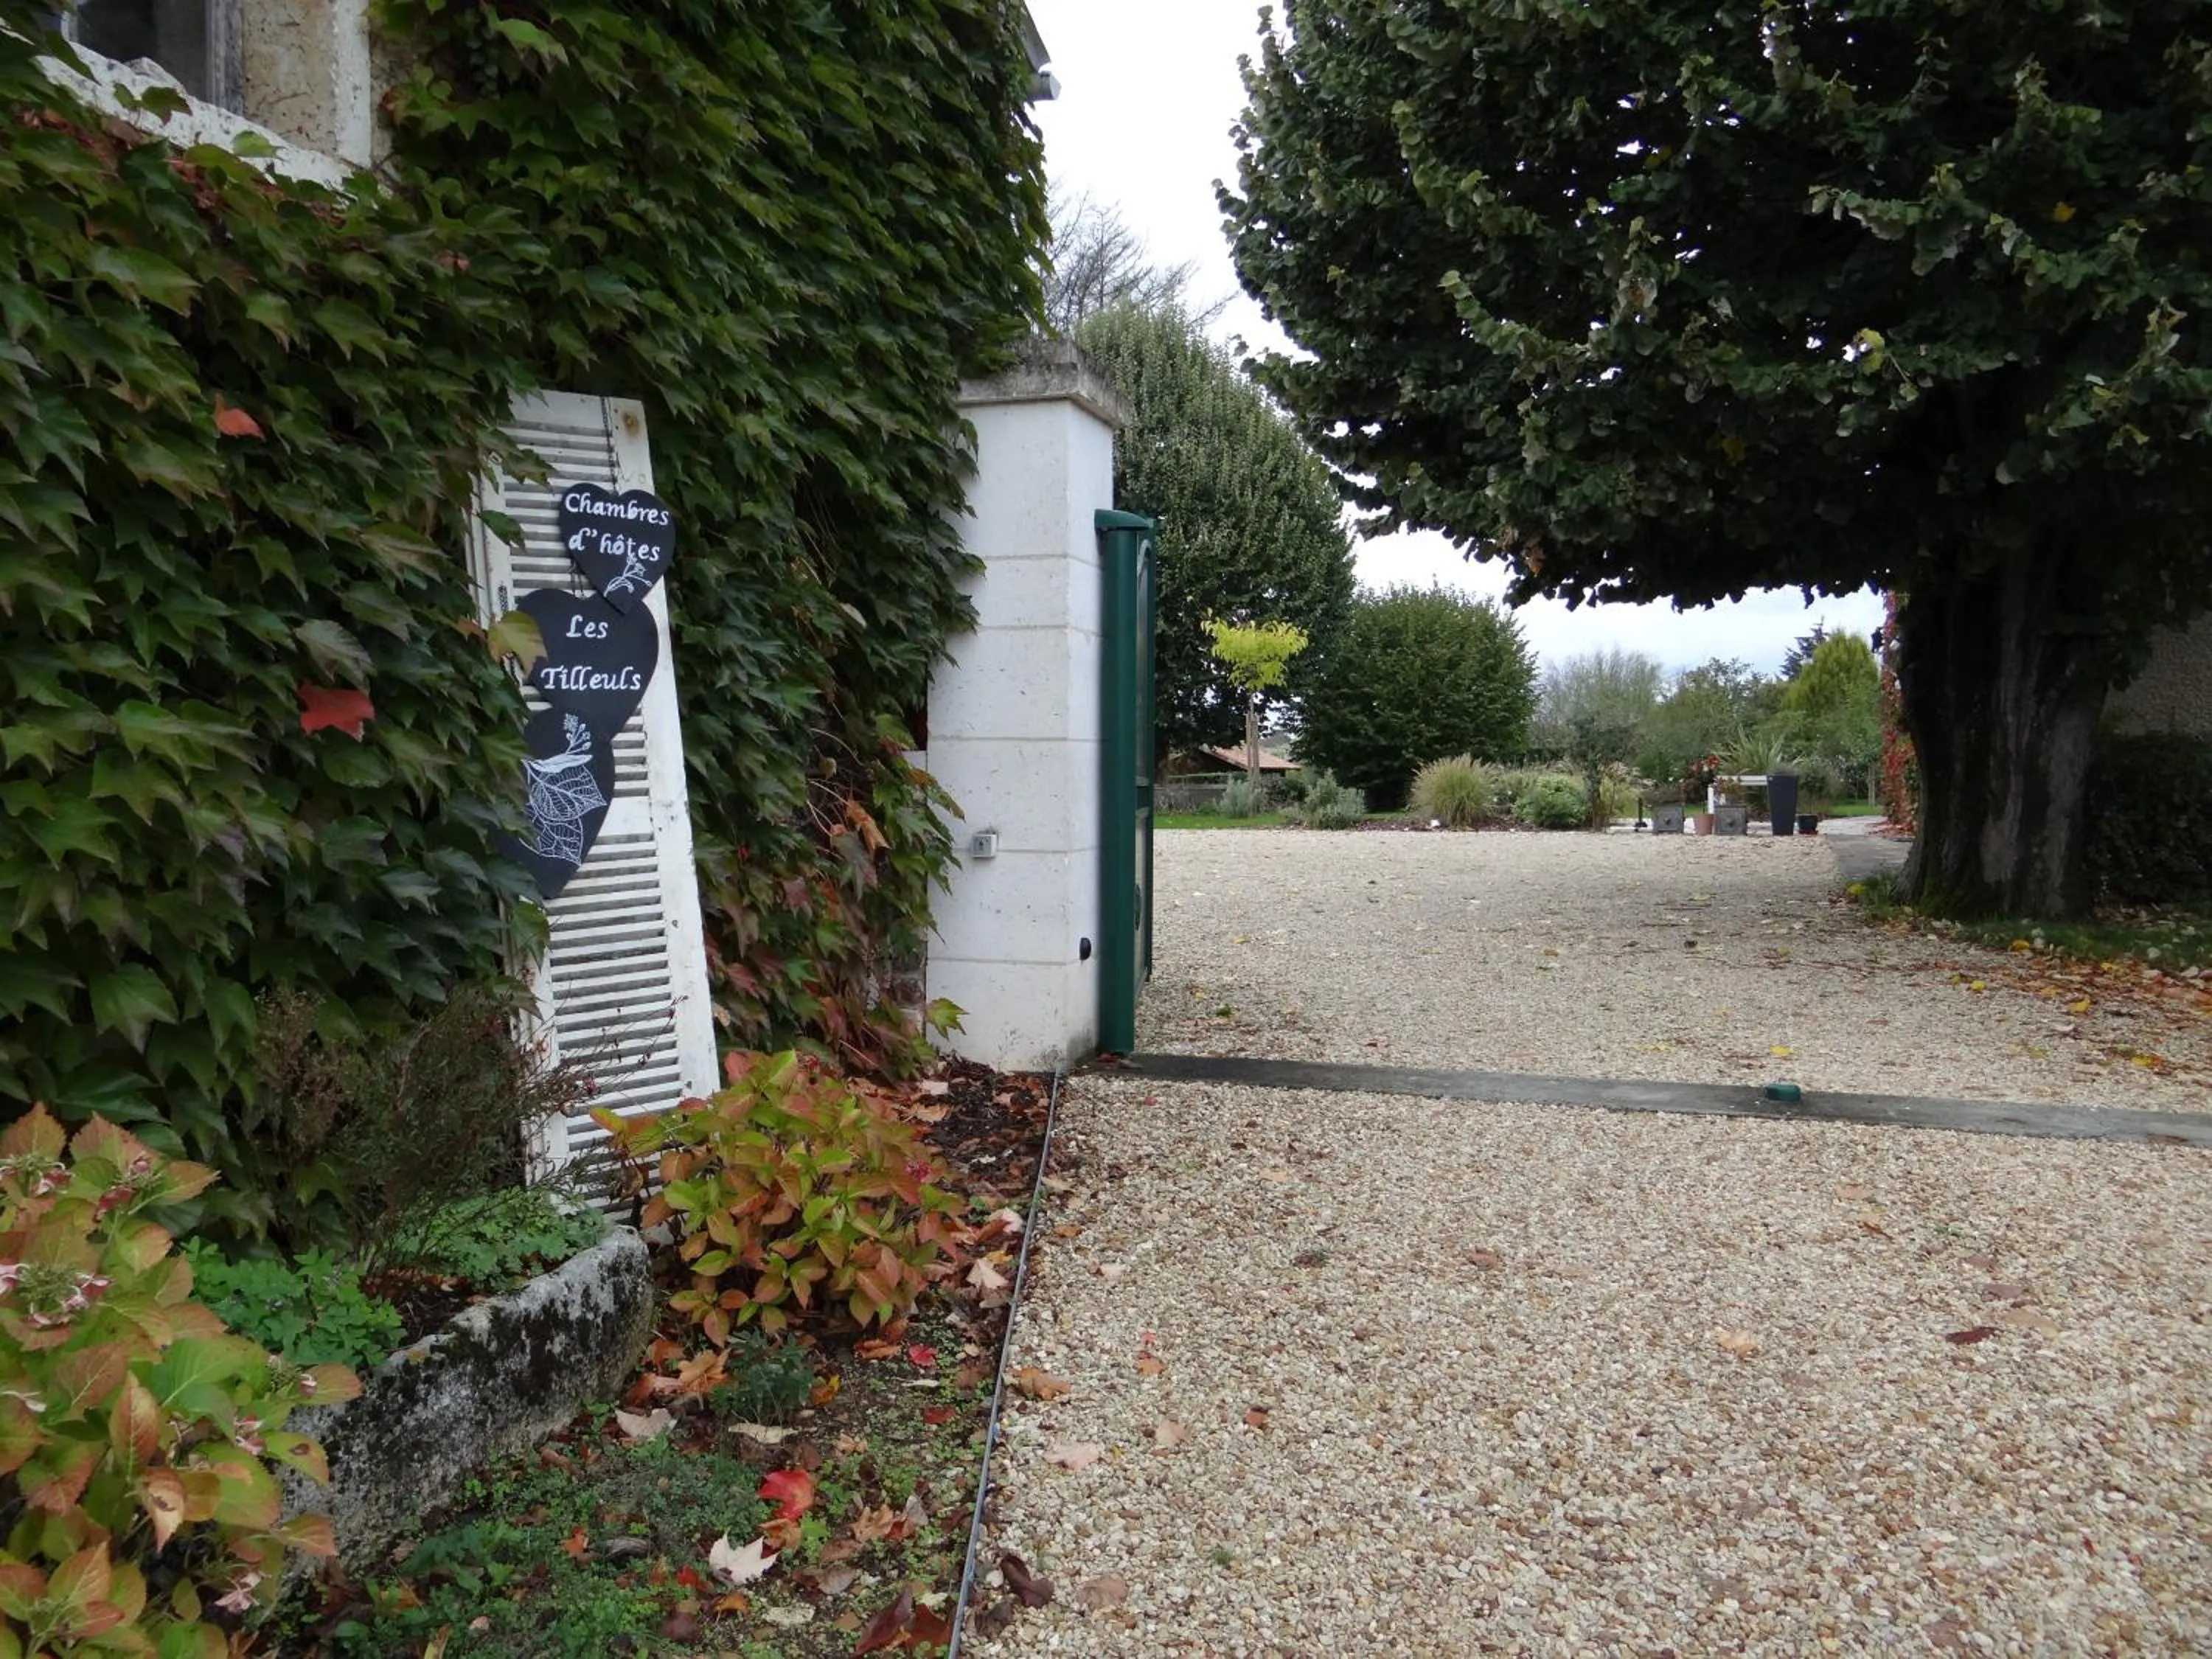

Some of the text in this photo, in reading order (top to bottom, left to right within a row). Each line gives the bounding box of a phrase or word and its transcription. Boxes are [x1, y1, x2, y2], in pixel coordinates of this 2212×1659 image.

[566, 492, 669, 526] Chambres
[566, 614, 608, 639] Les
[540, 665, 641, 691] Tilleuls
